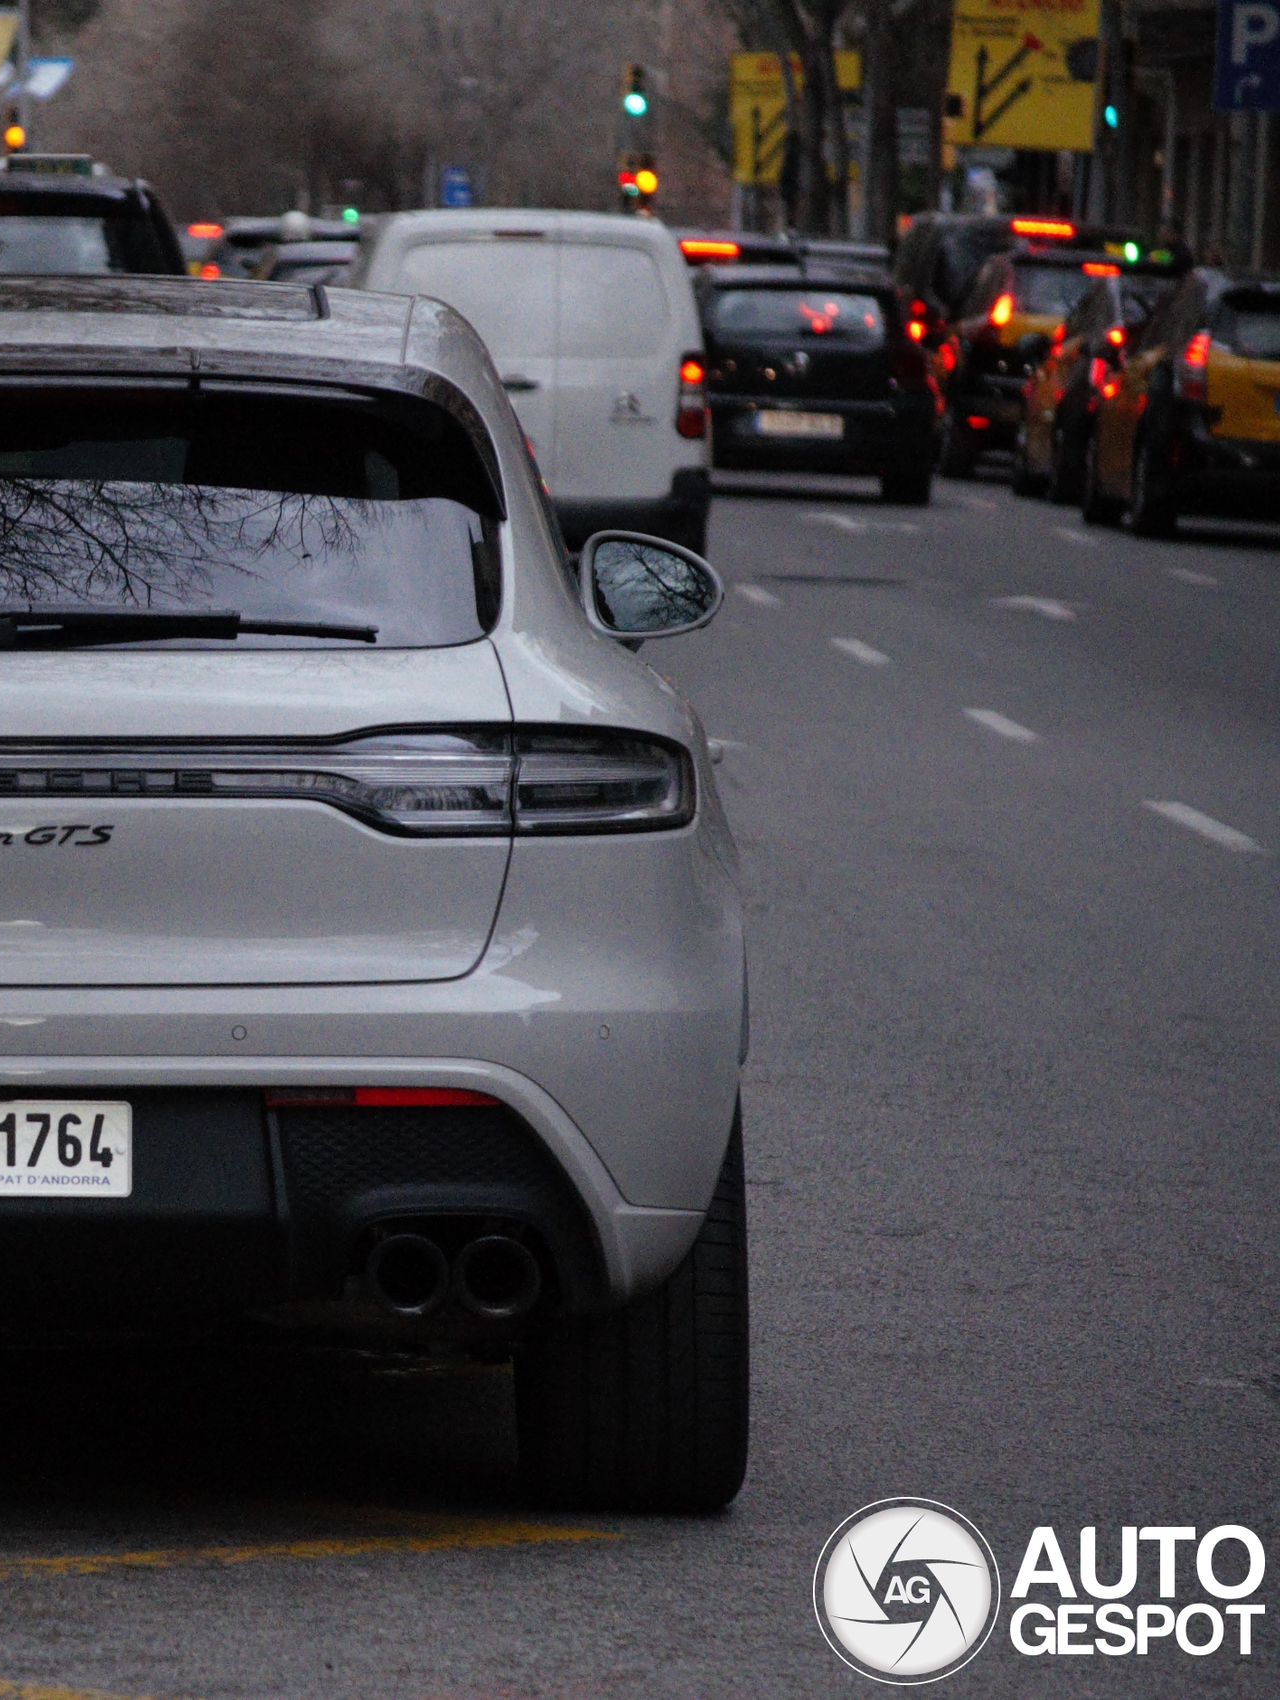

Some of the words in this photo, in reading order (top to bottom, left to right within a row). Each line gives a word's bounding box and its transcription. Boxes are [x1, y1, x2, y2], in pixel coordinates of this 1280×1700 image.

[1230, 4, 1279, 65] P
[23, 825, 115, 846] GTS
[27, 1175, 111, 1186] D'ANDORRA
